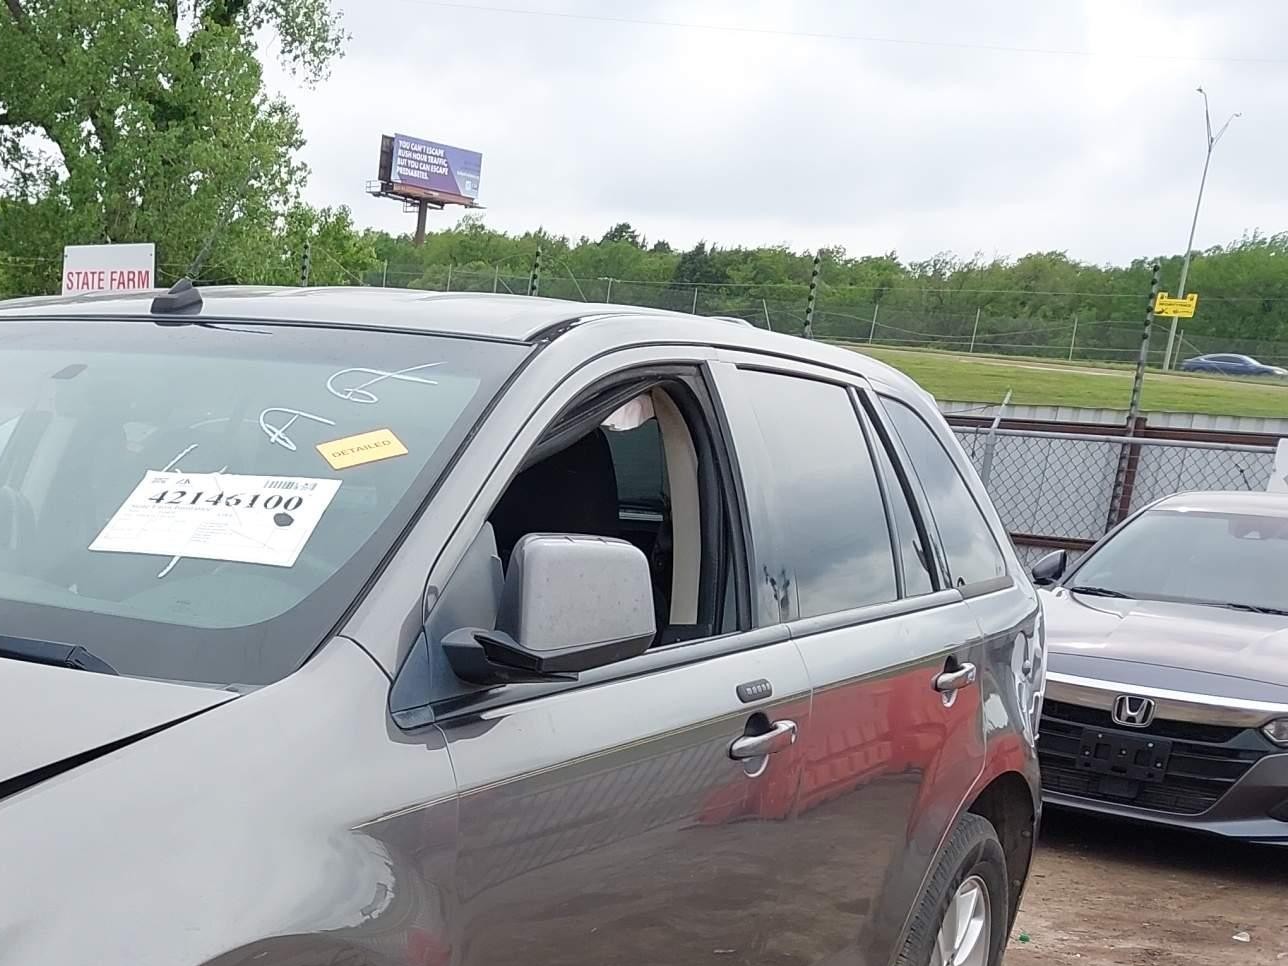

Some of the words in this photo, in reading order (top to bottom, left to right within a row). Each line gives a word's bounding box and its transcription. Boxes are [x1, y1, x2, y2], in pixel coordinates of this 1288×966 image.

[66, 271, 105, 290] STATE
[110, 270, 150, 290] FARM
[331, 440, 392, 458] DETAILED
[149, 489, 304, 512] 42146100
